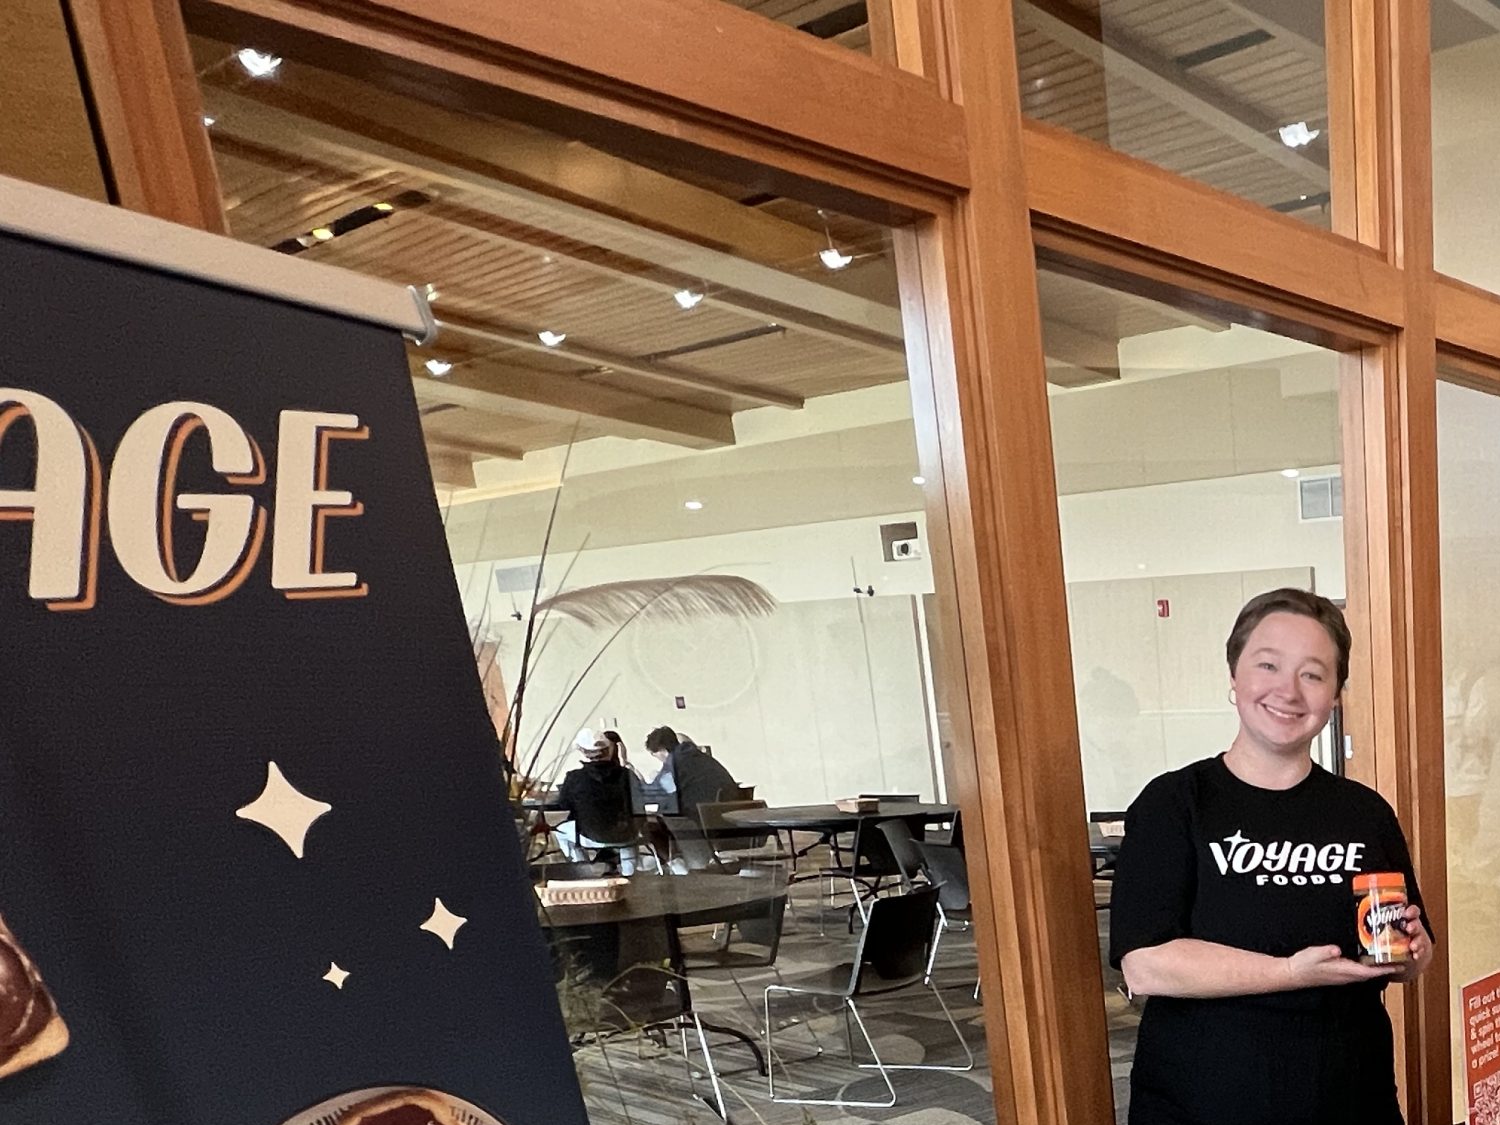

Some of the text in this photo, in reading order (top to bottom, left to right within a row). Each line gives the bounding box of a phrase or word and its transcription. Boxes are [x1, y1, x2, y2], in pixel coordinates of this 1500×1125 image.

[1209, 830, 1365, 875] VOYAGE
[1256, 874, 1343, 886] FOODS
[1469, 995, 1481, 1011] Fill
[1482, 990, 1495, 1005] out
[1470, 1006, 1491, 1027] quick
[1471, 1027, 1477, 1040] &
[1478, 1022, 1494, 1038] spin
[1471, 1033, 1494, 1055] wheel
